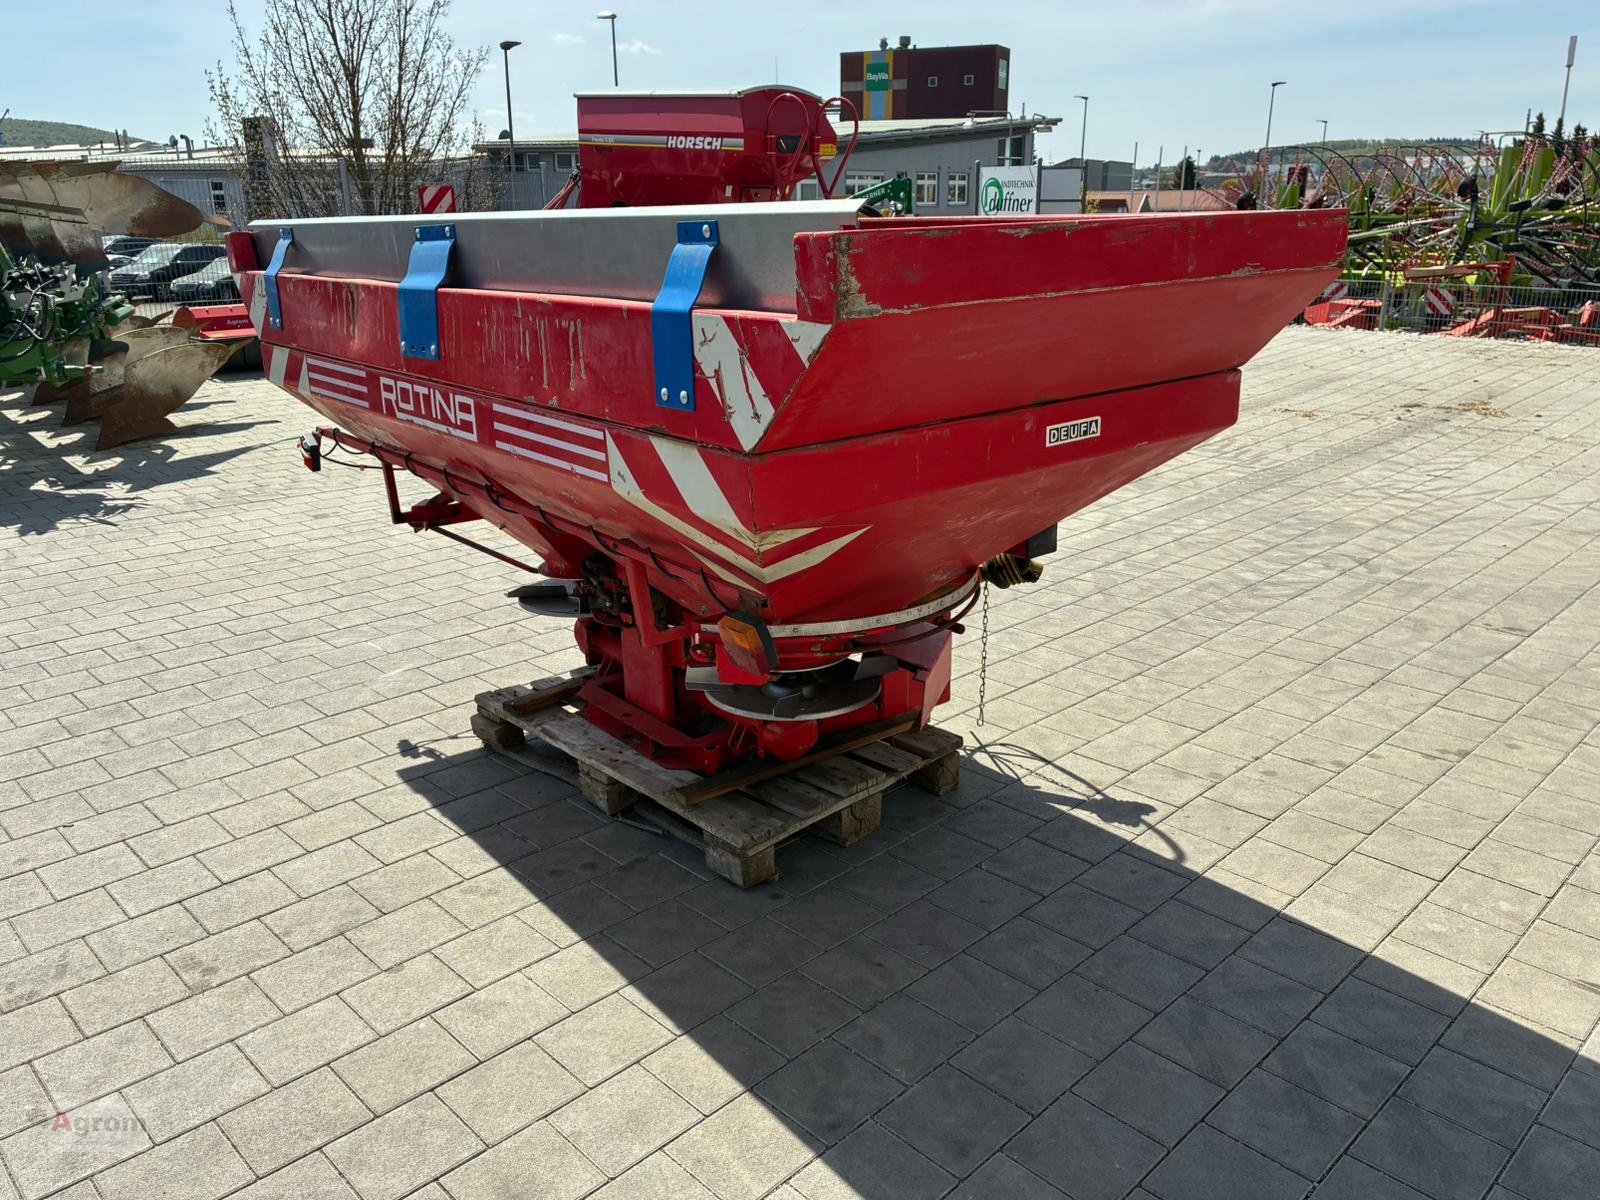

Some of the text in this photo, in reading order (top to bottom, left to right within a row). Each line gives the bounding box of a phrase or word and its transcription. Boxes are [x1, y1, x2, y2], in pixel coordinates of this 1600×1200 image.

[866, 72, 888, 80] BayWa
[667, 135, 722, 150] HORSCH
[380, 376, 478, 442] ROTINA
[1049, 420, 1098, 443] DEUFA
